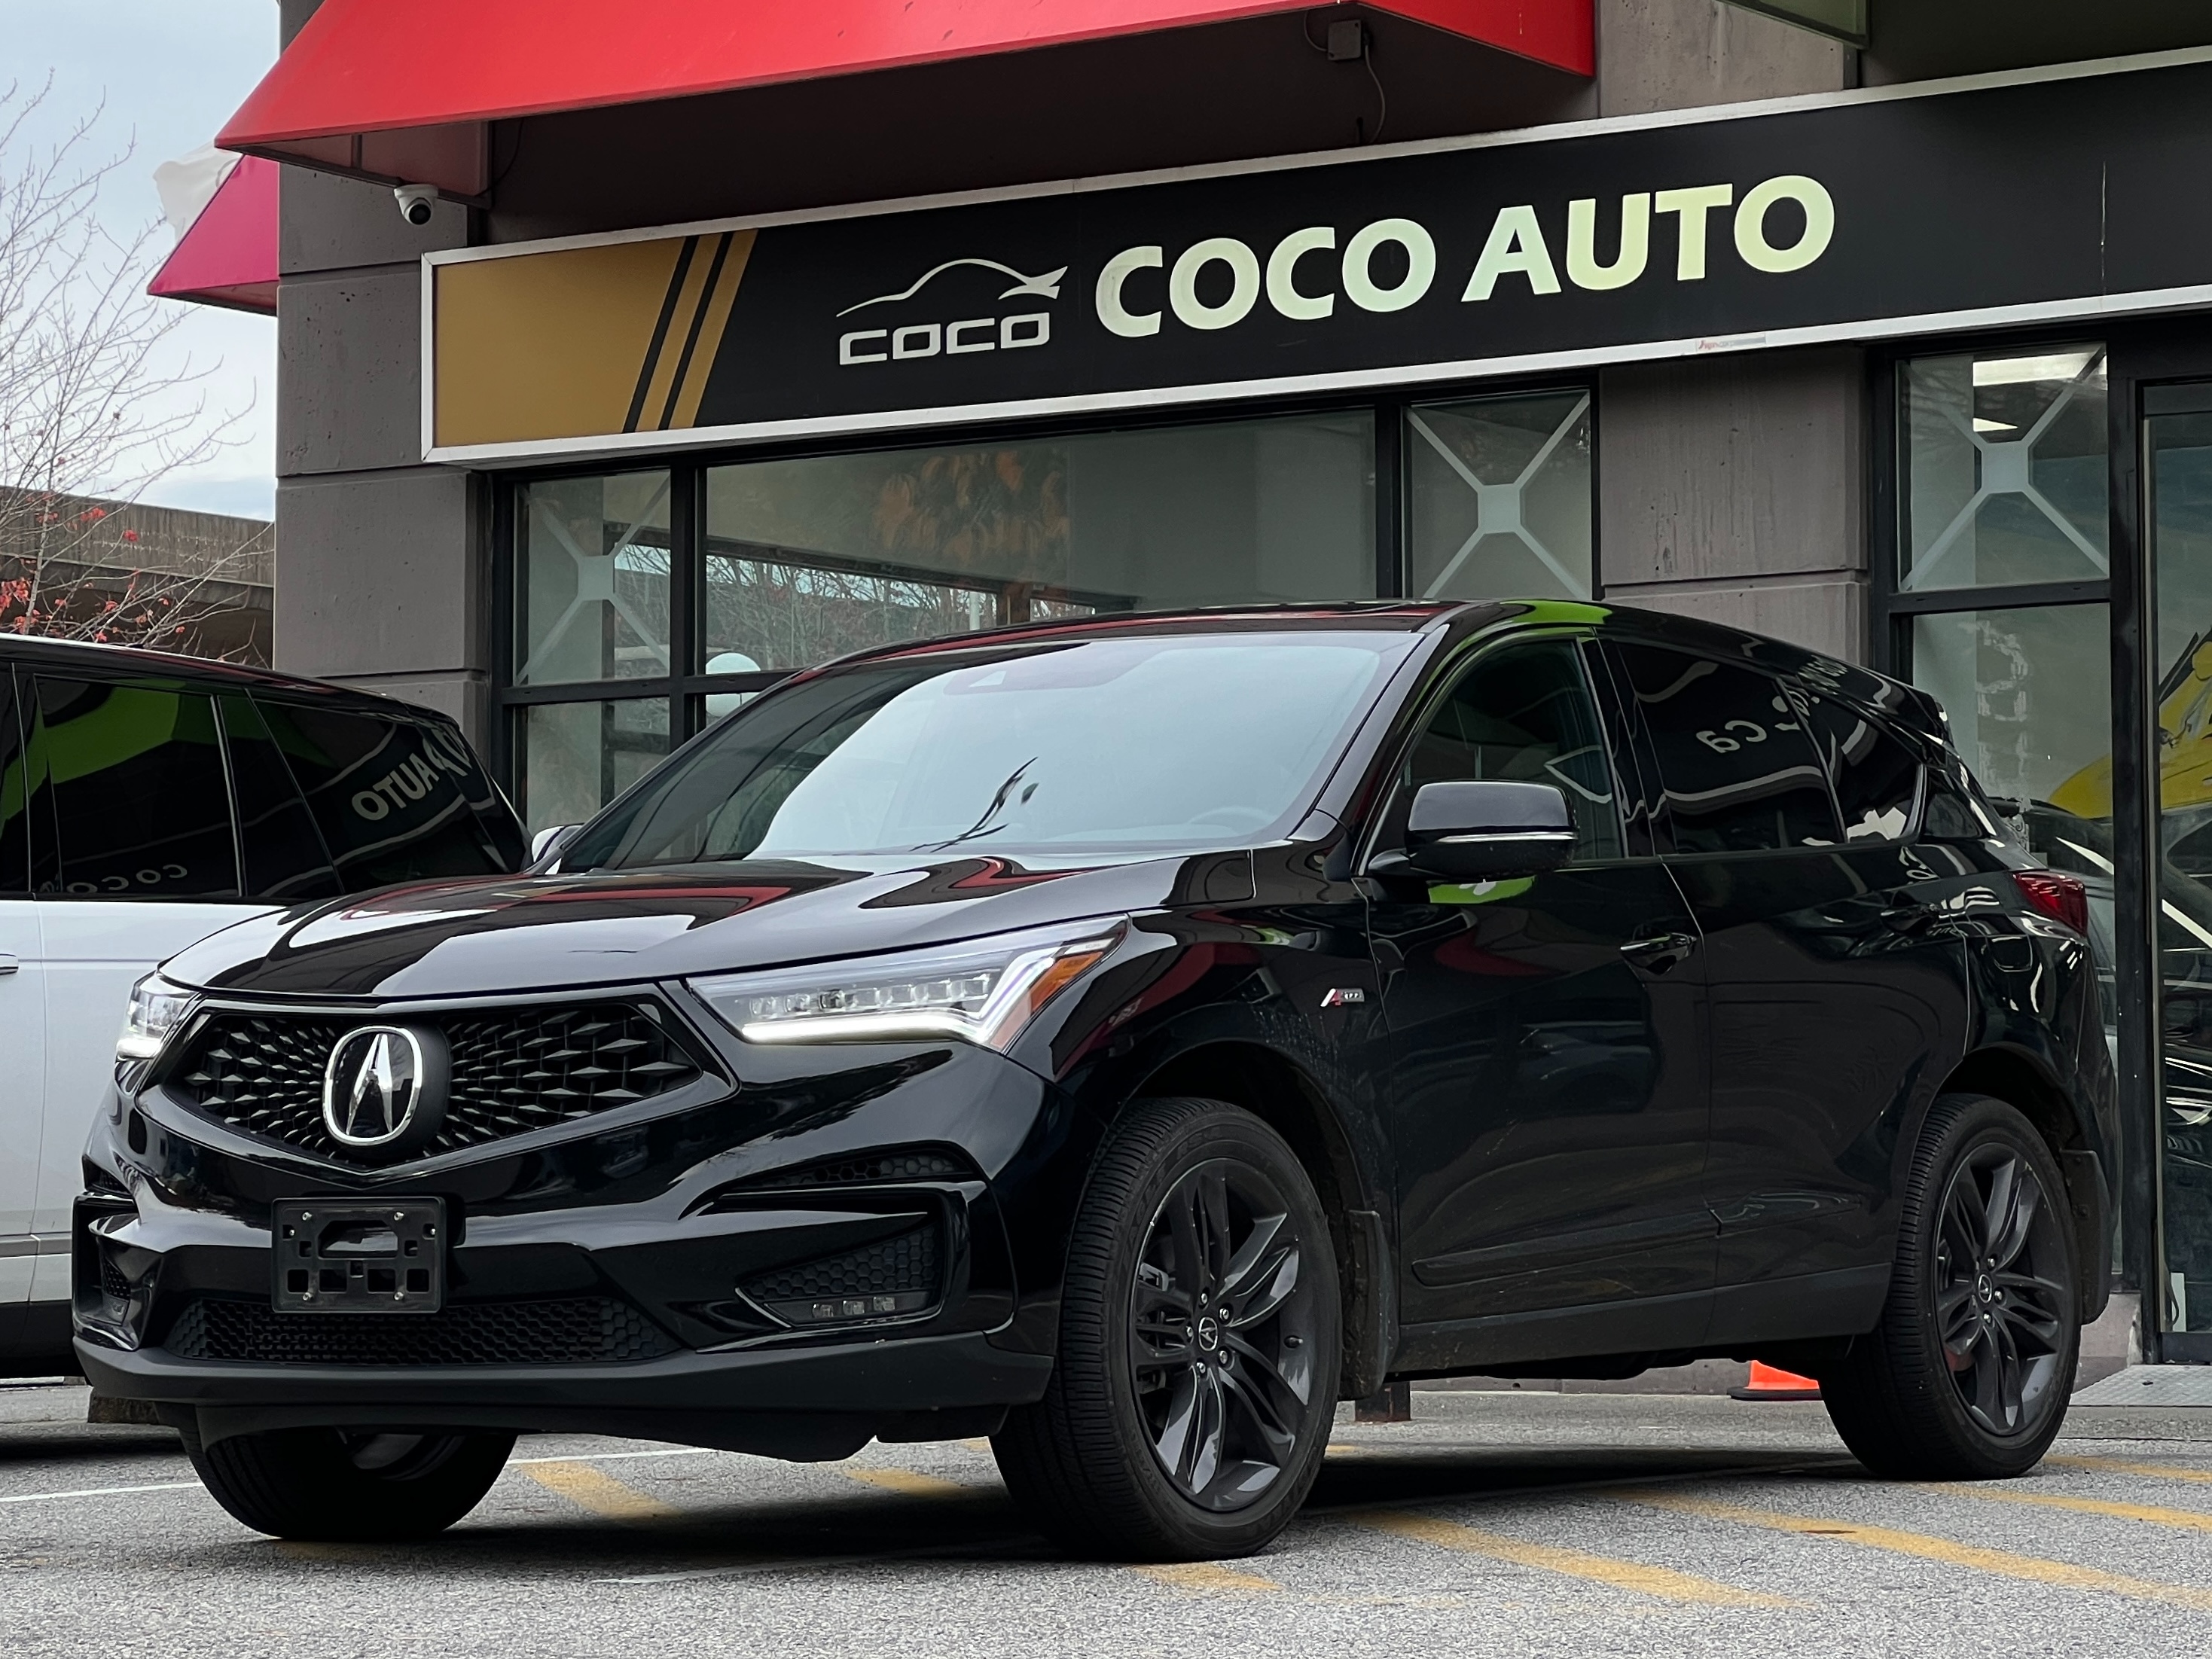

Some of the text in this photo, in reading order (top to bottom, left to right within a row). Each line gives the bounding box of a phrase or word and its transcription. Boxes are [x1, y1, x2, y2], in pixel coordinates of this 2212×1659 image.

[1096, 175, 1835, 337] COCO AUTO
[839, 312, 1050, 364] COCO
